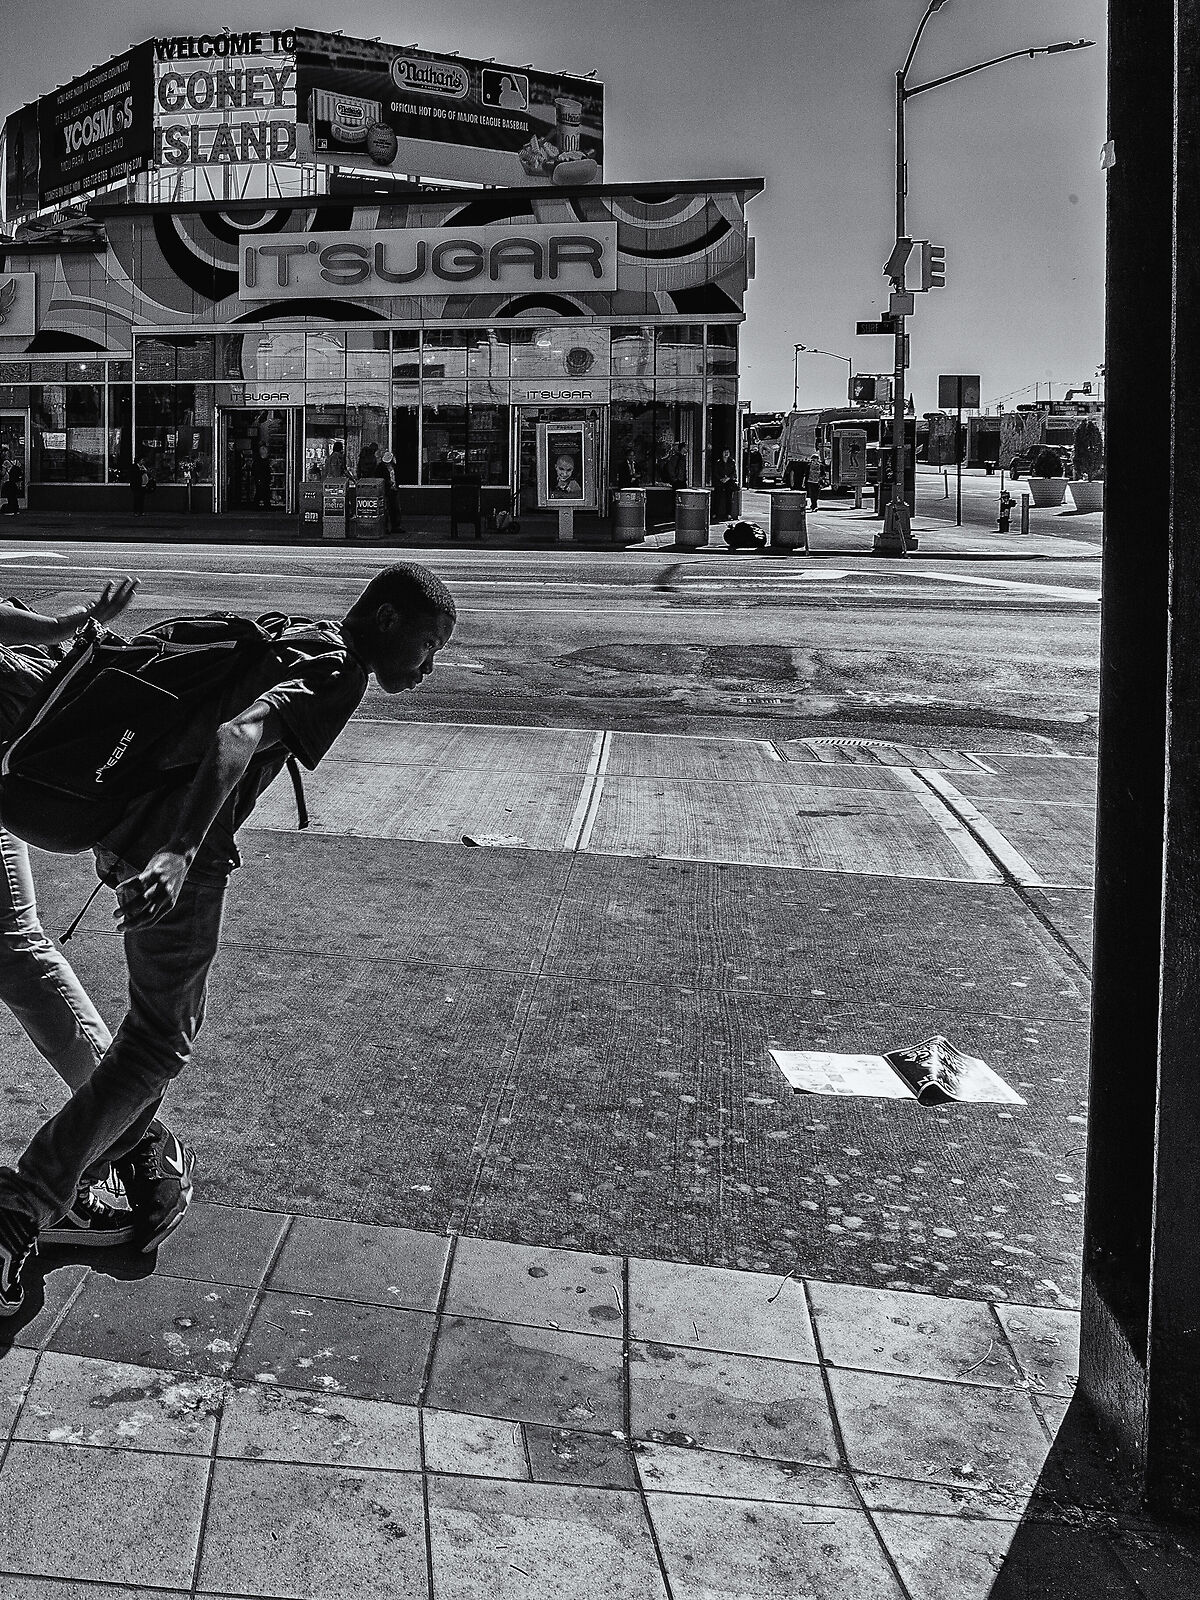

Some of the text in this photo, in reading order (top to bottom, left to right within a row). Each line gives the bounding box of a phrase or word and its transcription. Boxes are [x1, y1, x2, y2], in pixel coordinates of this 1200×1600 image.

[154, 29, 296, 60] WELCOME TO
[158, 66, 294, 112] CONEY
[398, 60, 464, 91] Nathan's
[390, 102, 529, 132] OFFICIAL HOT DOG OF MAJOR LEAGUE BASEBALL
[154, 120, 297, 166] ISLAND
[245, 235, 604, 288] IT'SUGAR
[861, 323, 878, 334] SURF
[527, 390, 593, 399] IT'SUGAR
[357, 500, 377, 508] VOICE
